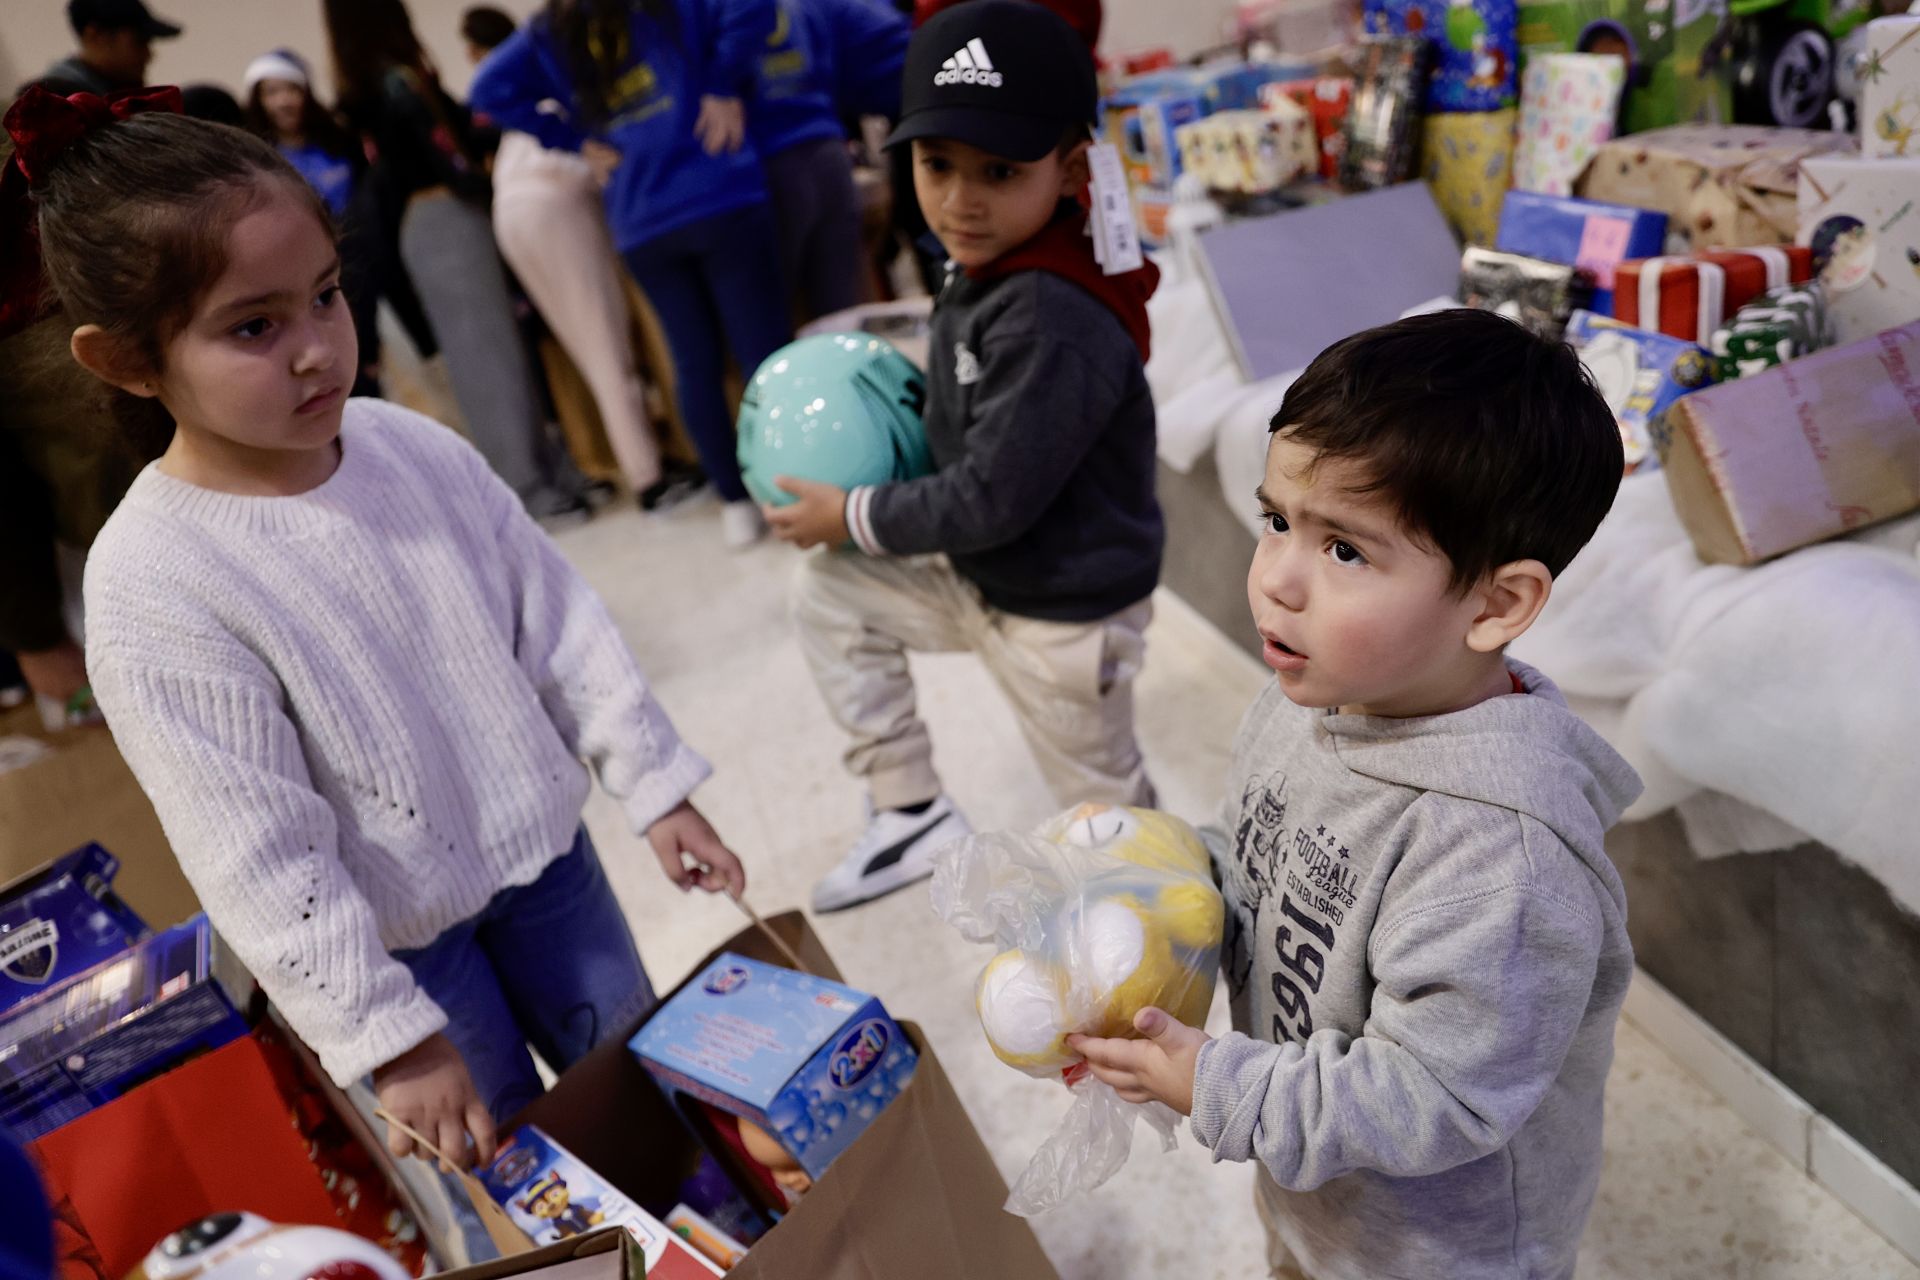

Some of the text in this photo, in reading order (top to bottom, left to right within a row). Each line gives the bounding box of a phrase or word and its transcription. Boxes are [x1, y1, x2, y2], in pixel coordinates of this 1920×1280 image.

[934, 68, 1003, 88] adidas
[1293, 827, 1357, 901] FOOTBALL
[1306, 866, 1354, 909] League
[1287, 869, 1344, 927] ESTABLISHED
